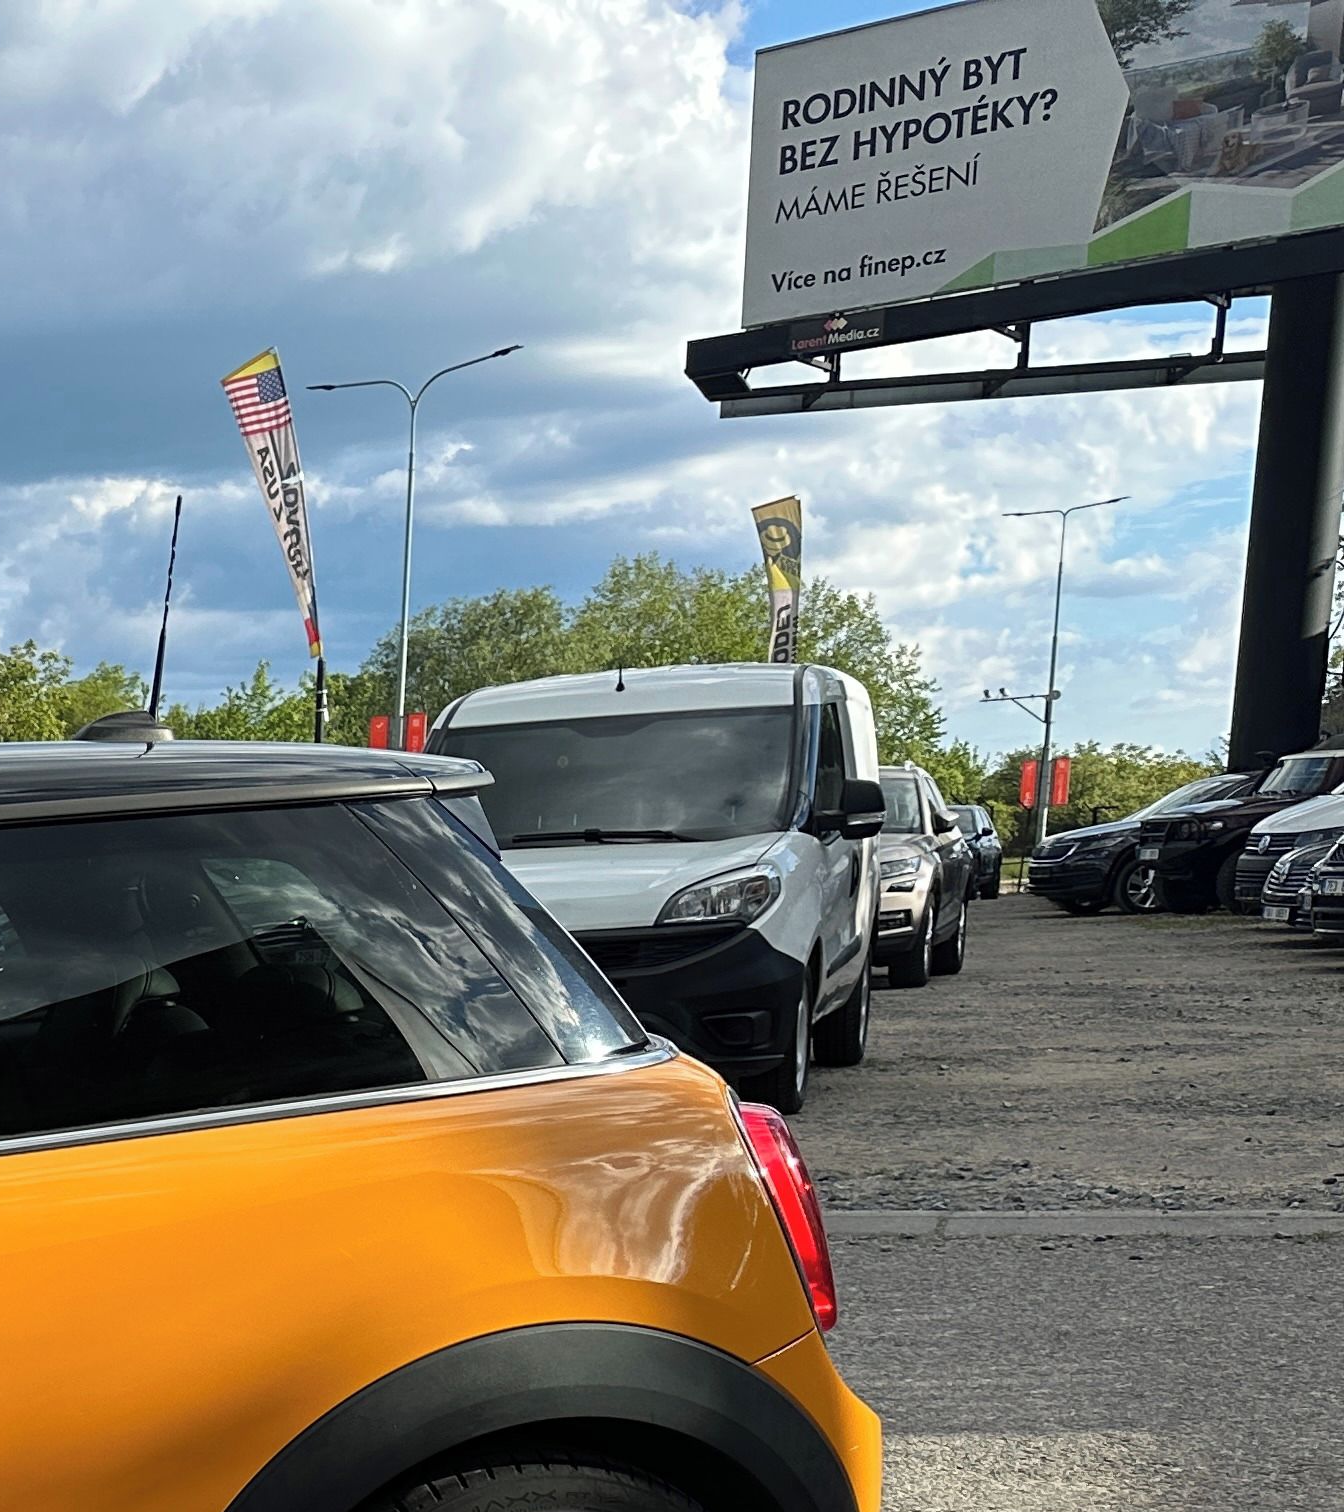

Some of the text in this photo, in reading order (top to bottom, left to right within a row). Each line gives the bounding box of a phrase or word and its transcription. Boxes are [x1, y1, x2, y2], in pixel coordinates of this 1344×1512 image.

[781, 48, 1027, 130] RODINNÝ BYT
[779, 88, 1058, 175] BEZ HYPOTÉKY?
[775, 153, 981, 224] MÁME ŘEŠENÍ
[772, 249, 947, 292] Více na finep.cz
